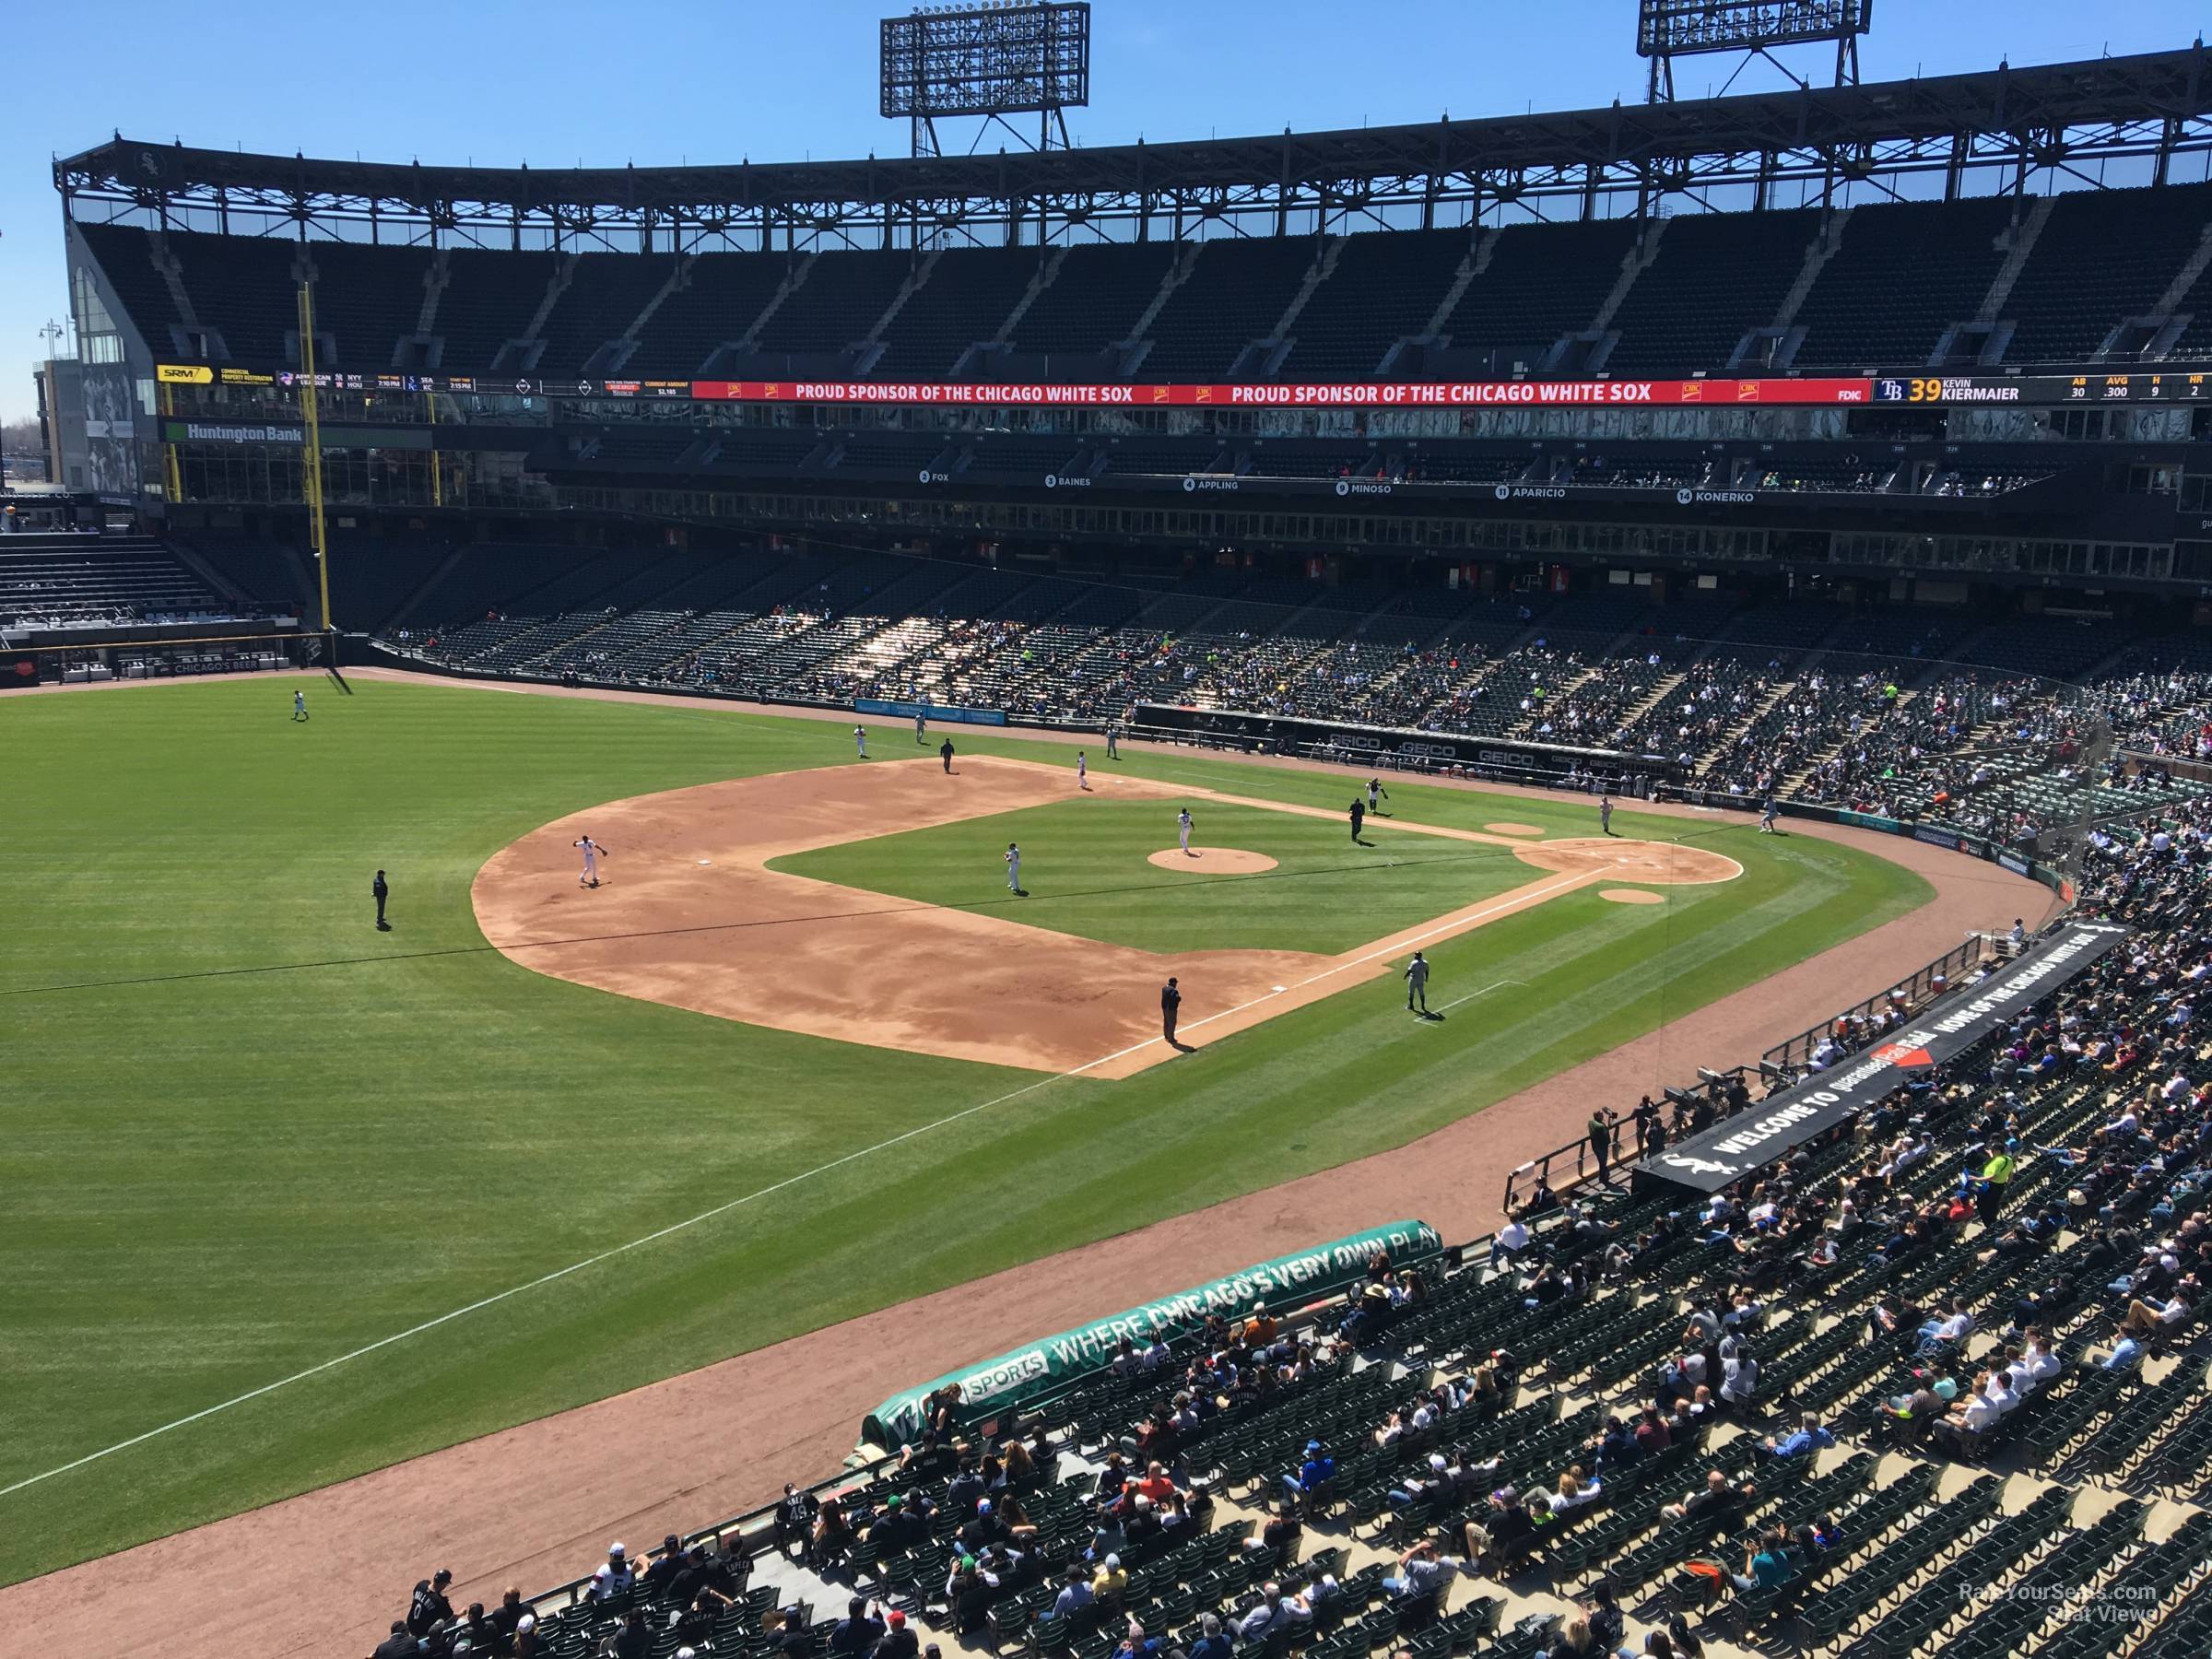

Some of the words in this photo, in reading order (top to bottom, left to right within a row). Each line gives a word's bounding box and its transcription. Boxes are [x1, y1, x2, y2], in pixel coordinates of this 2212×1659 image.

[1942, 379, 1971, 388] KEVIN
[796, 384, 845, 399] PROUD
[849, 384, 918, 400] SPONSOR
[922, 385, 940, 400] OF
[943, 386, 971, 401] THE
[975, 385, 1042, 402] CHICAGO
[1046, 386, 1097, 402] WHITE
[1100, 386, 1133, 402] SOX
[1232, 386, 1290, 402] PROUD
[1295, 385, 1377, 402] SPONSOR
[1382, 385, 1406, 402] OF
[1410, 385, 1445, 402] THE
[1450, 384, 1534, 402] CHICAGO
[1539, 383, 1605, 401] WHITE
[1609, 382, 1652, 400] SOX
[1838, 390, 1861, 400] FDIC
[1909, 379, 1942, 402] 39
[1941, 388, 2019, 401] KIERMAIER
[2071, 387, 2086, 397] 30
[2104, 387, 2128, 396] .300
[2152, 386, 2159, 396] 9
[2191, 386, 2198, 395] 2
[188, 424, 265, 443] Huntington
[266, 426, 301, 441] Bank
[932, 473, 949, 481] FOX
[1058, 477, 1090, 486] BAINES
[1198, 481, 1239, 489] APPLING
[1351, 484, 1391, 494] MINOSO
[1512, 488, 1566, 498] APARICIO
[1696, 492, 1754, 502] KONERKO
[175, 660, 230, 674] CHICAGO'S
[232, 659, 257, 670] BEER
[1329, 734, 1381, 749] GEICO
[1478, 749, 1535, 767] GEICO
[1551, 754, 1583, 766] GEICO
[1934, 1008, 1983, 1033] HOME
[1974, 999, 1996, 1013] OF
[1988, 986, 2019, 1003] THE
[2005, 960, 2056, 992] CHICAGO
[2041, 945, 2081, 966] WHITE
[2069, 932, 2098, 947] SOX
[1829, 1057, 1893, 1092] guaranteed
[1896, 1030, 1938, 1050] Field
[1712, 1102, 1819, 1155] WELCOME
[1803, 1091, 1841, 1108] TO
[970, 1356, 1043, 1395] SPORTS
[1052, 1315, 1148, 1366] WHERE
[1147, 1271, 1275, 1330] CHICAGO'S
[1270, 1253, 1332, 1288] VERY
[1334, 1237, 1386, 1269] OWN
[1390, 1227, 1439, 1256] PLAY
[787, 1496, 805, 1507] SALE
[790, 1504, 807, 1521] 49
[613, 1579, 624, 1594] 5
